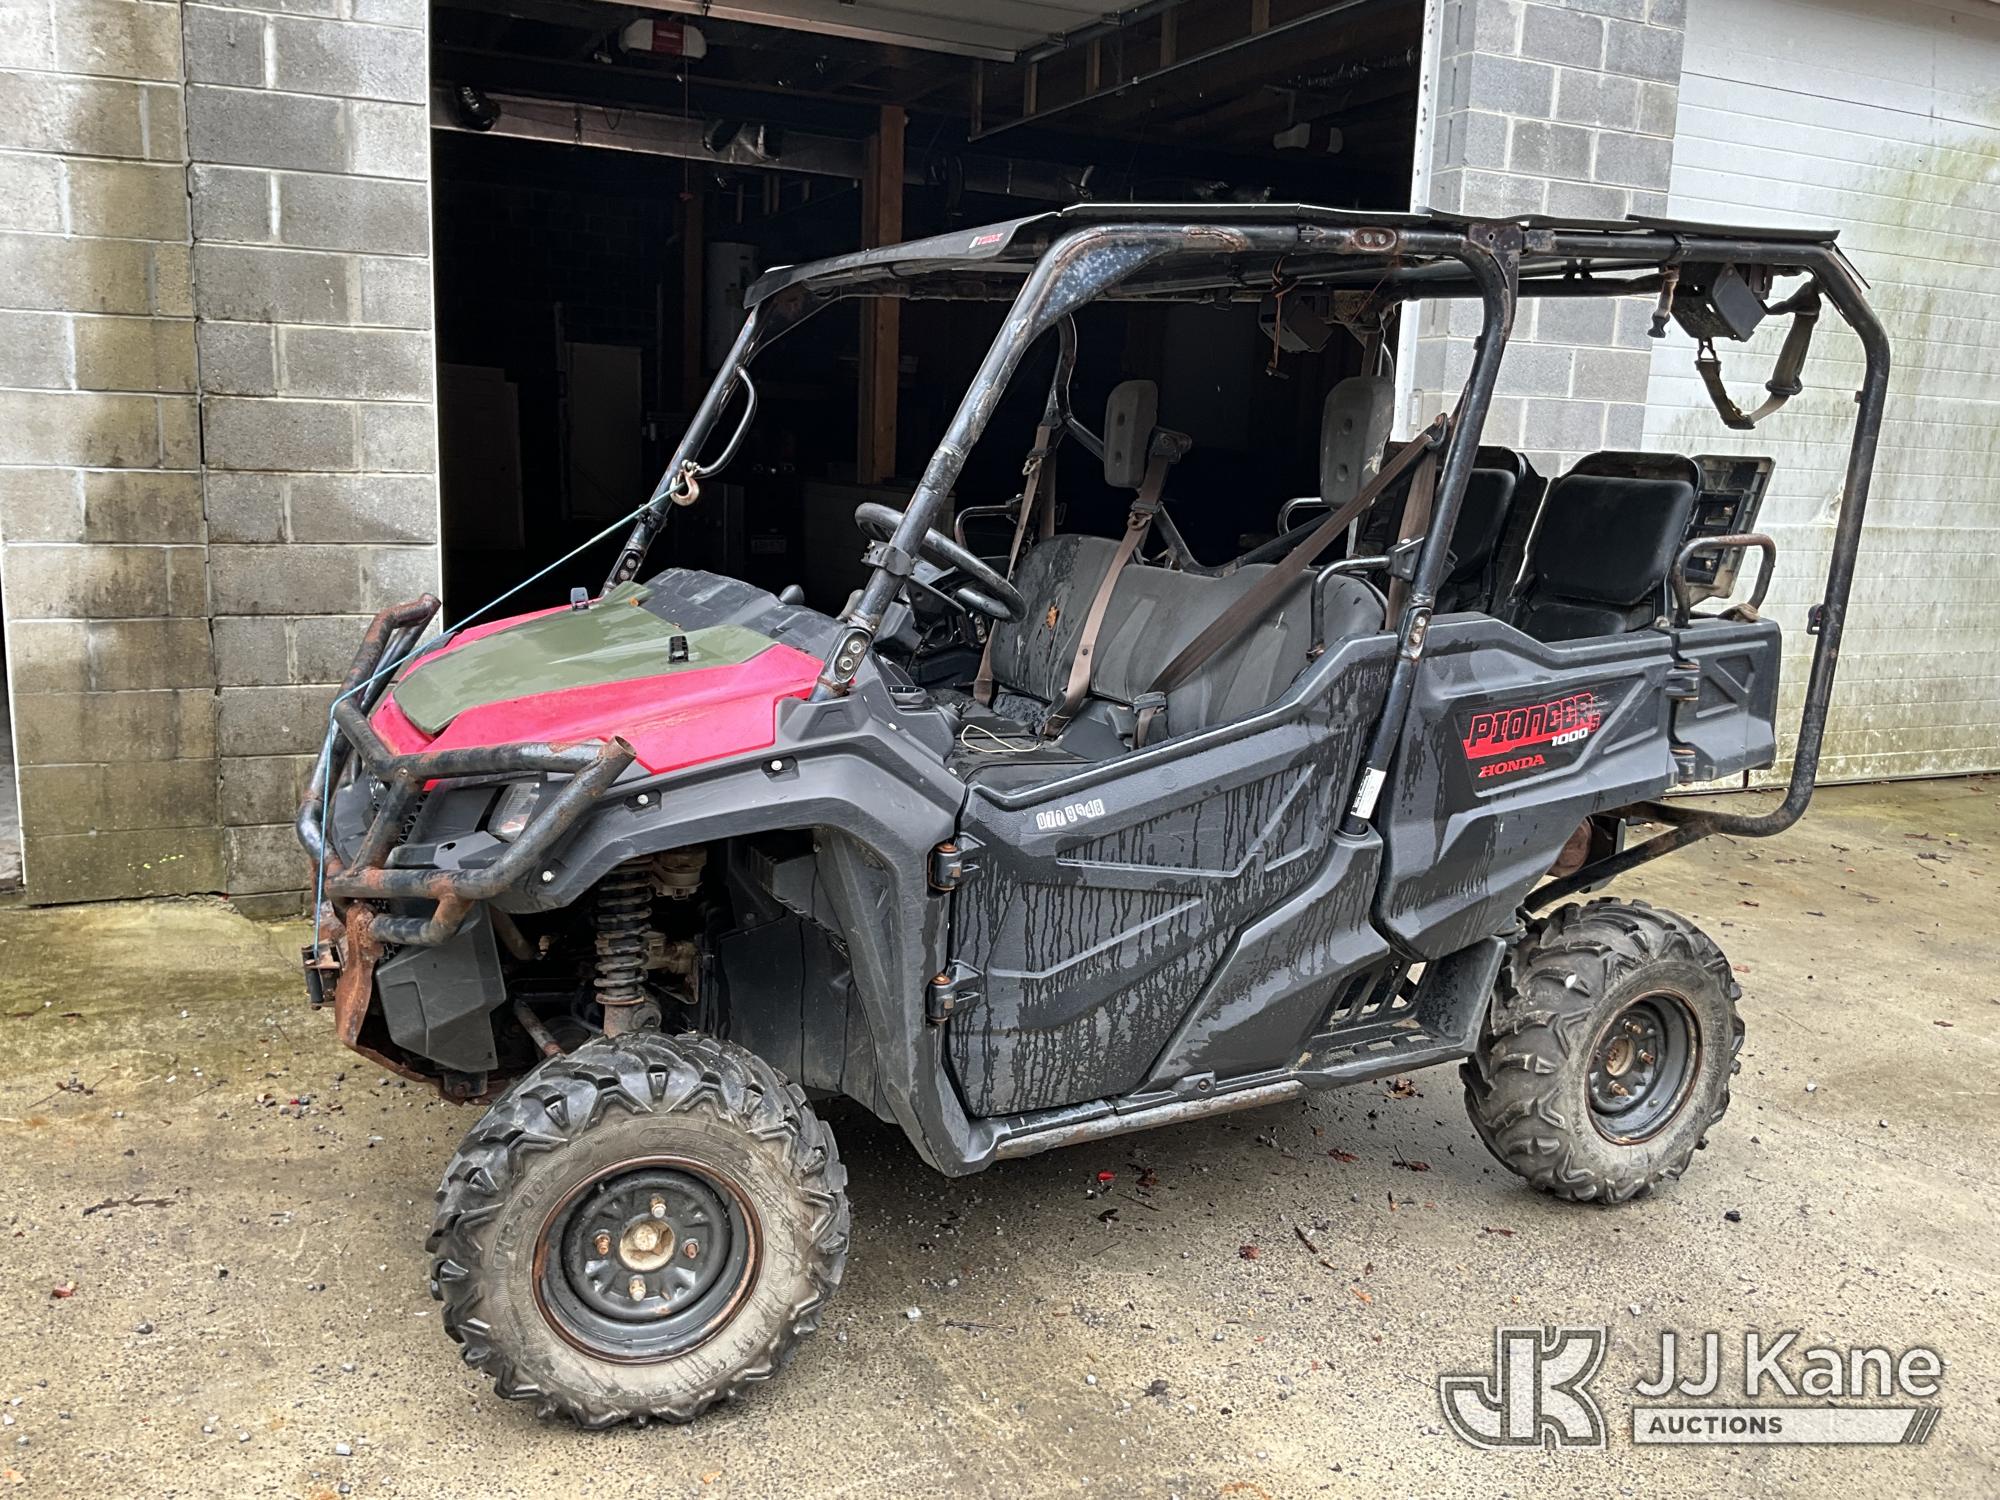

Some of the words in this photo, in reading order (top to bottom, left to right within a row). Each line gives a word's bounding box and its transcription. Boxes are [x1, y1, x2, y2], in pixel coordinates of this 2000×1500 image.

[1468, 692, 1594, 748] PIONEER
[1551, 727, 1590, 747] 1000
[1478, 753, 1546, 778] HONDA
